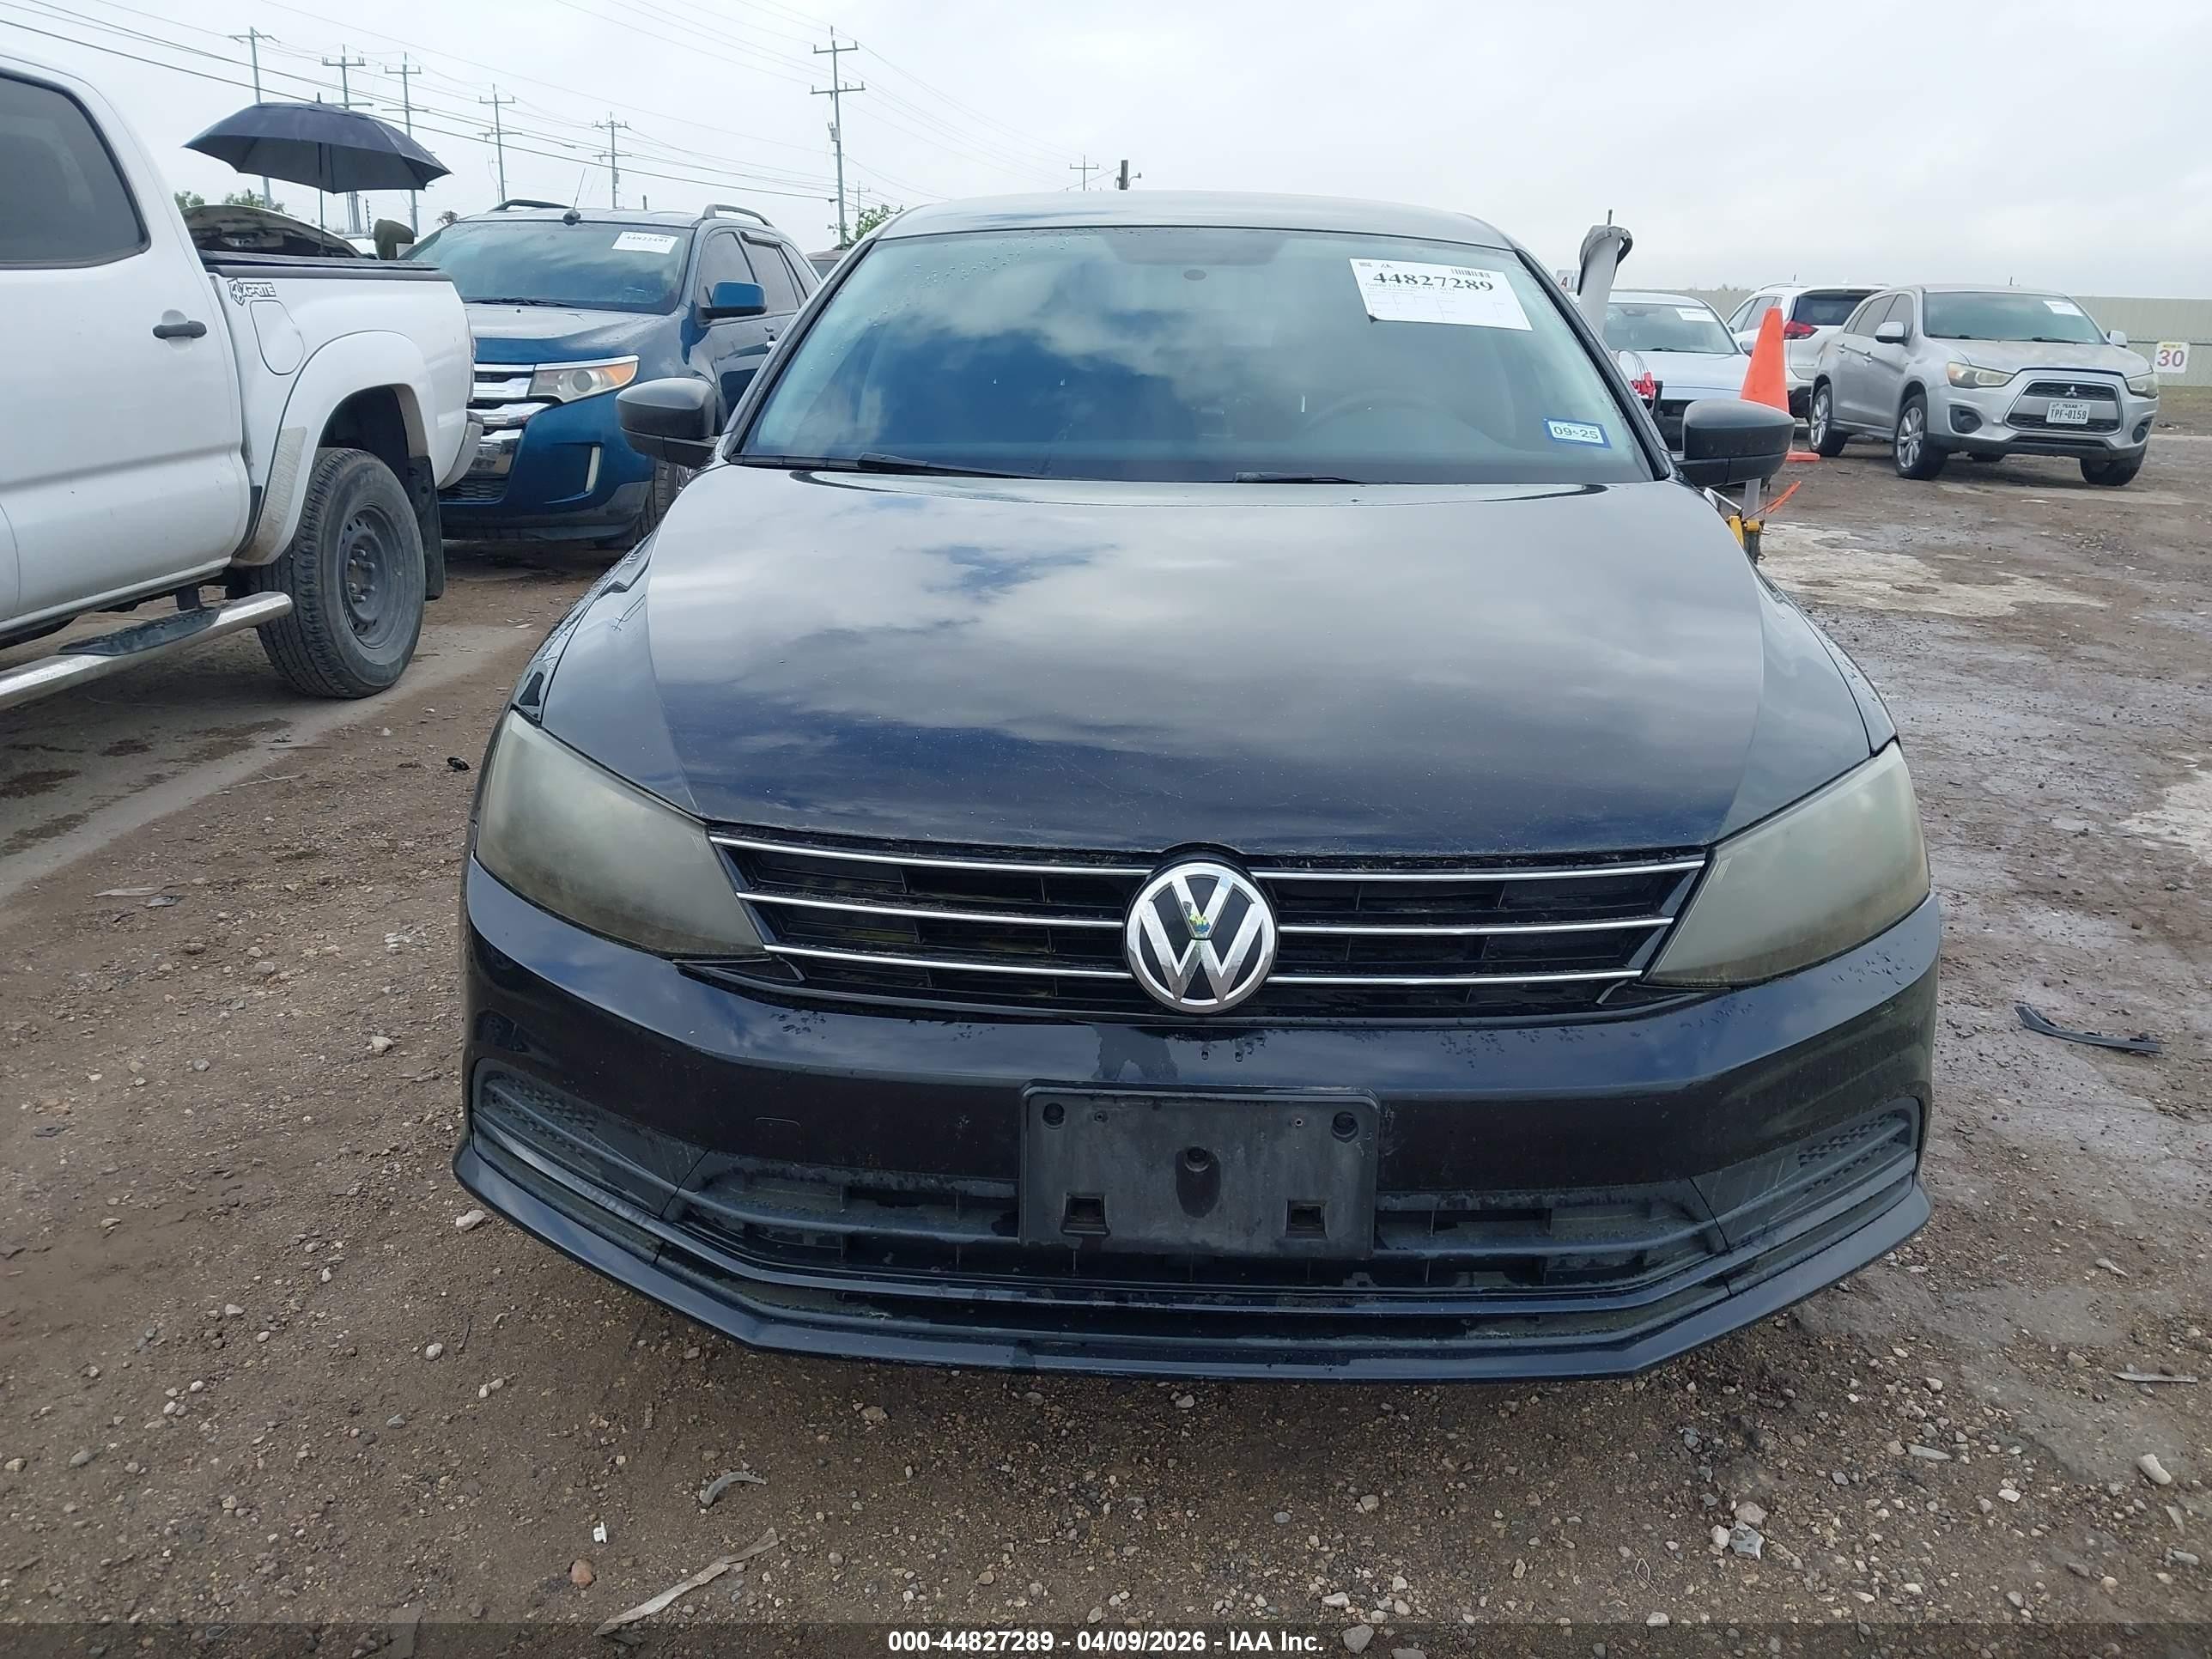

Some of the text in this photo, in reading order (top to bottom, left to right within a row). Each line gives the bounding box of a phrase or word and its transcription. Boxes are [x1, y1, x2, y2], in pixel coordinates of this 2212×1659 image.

[1373, 271, 1494, 291] 44827289
[2156, 349, 2185, 368] 30
[1127, 862, 1275, 1013] VW
